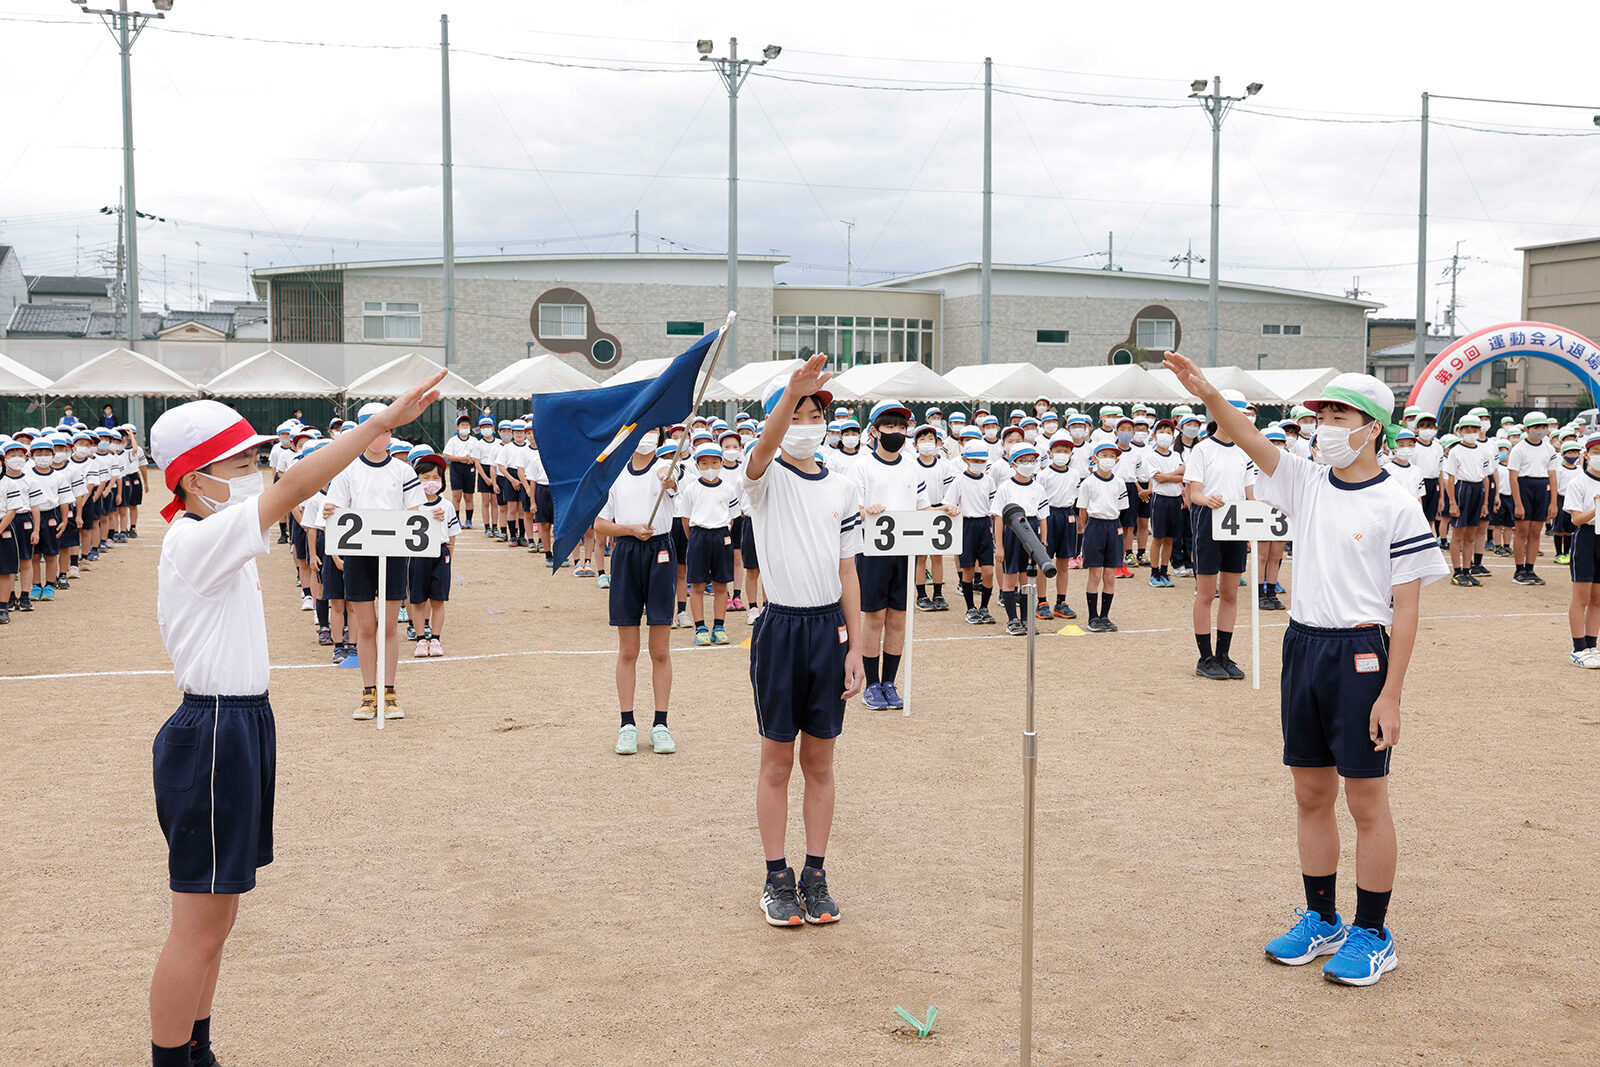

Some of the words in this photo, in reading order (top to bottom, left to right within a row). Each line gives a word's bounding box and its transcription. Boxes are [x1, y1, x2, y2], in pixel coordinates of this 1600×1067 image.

[1488, 331, 1600, 375] 運動会入退場
